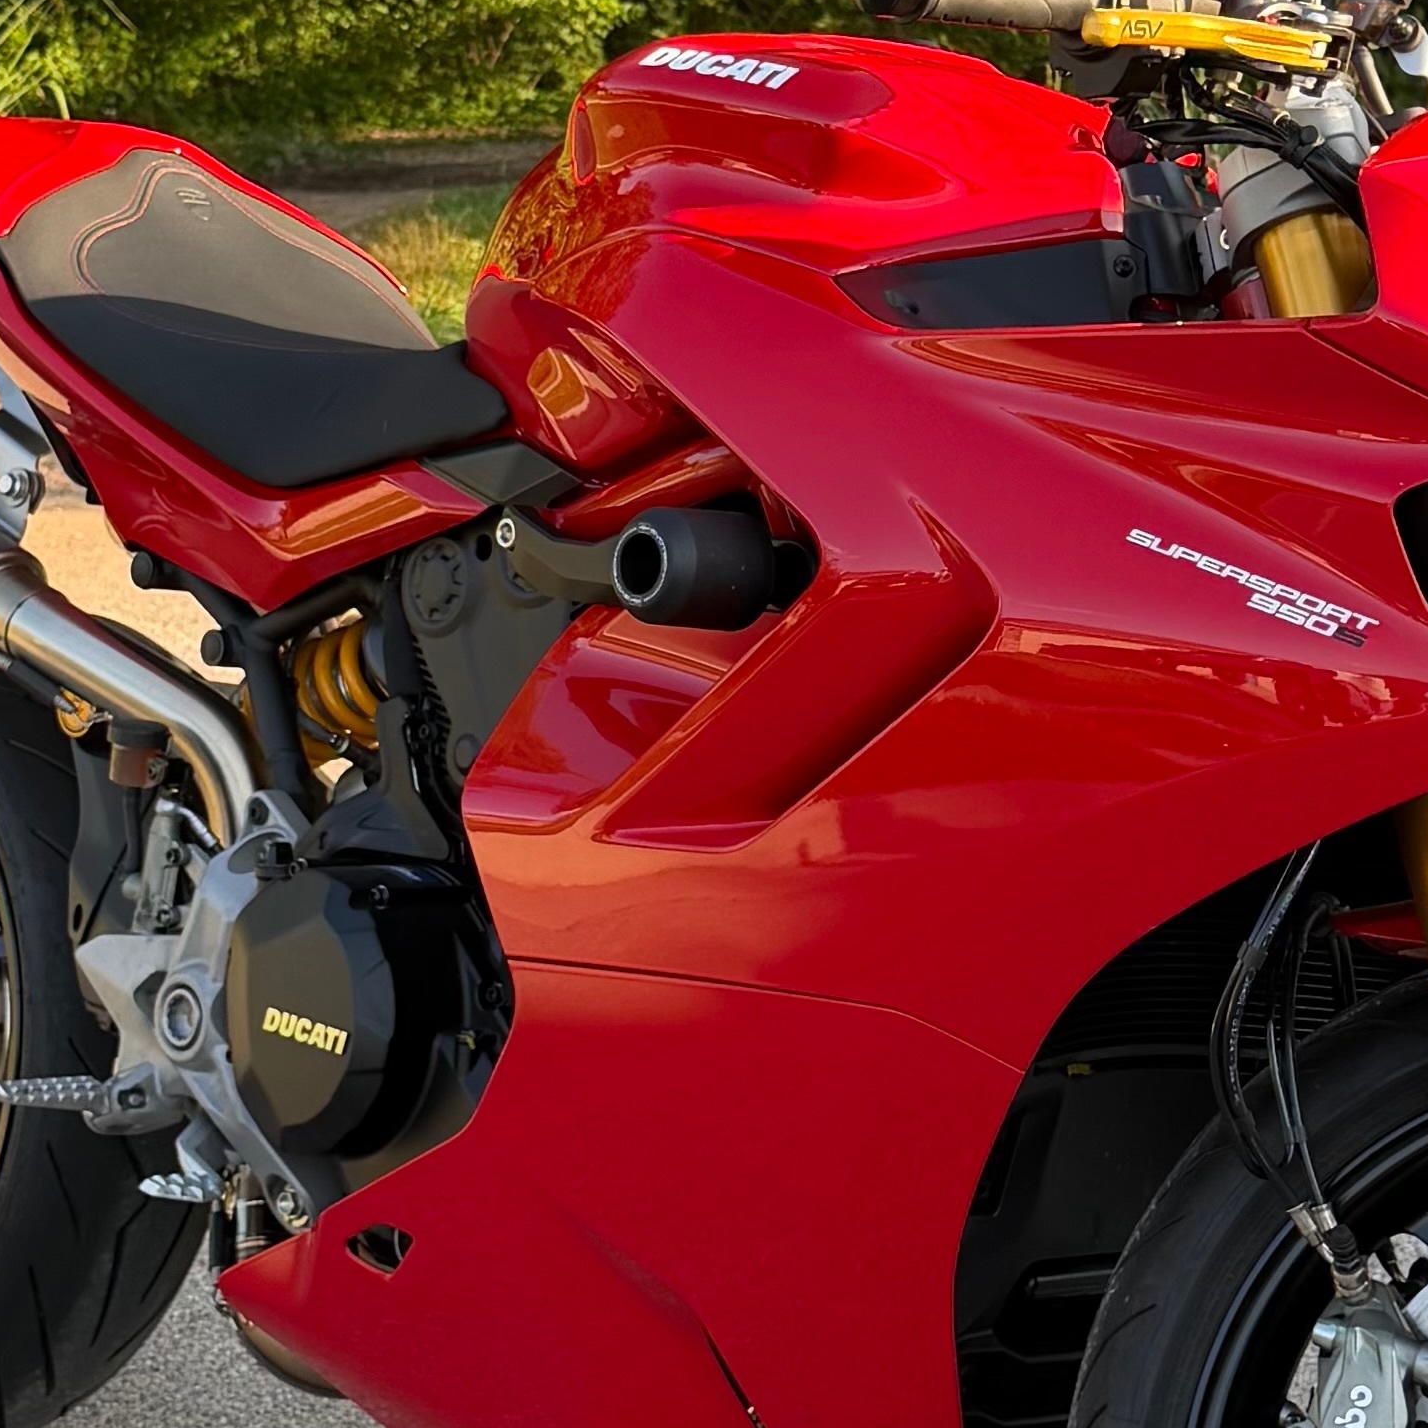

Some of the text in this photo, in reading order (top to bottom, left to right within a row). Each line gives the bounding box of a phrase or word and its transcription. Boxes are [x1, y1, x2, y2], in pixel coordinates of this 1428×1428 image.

[639, 47, 799, 90] DUCATI
[1126, 528, 1380, 632] SUPERSPORT
[262, 1007, 349, 1056] DUCATI
